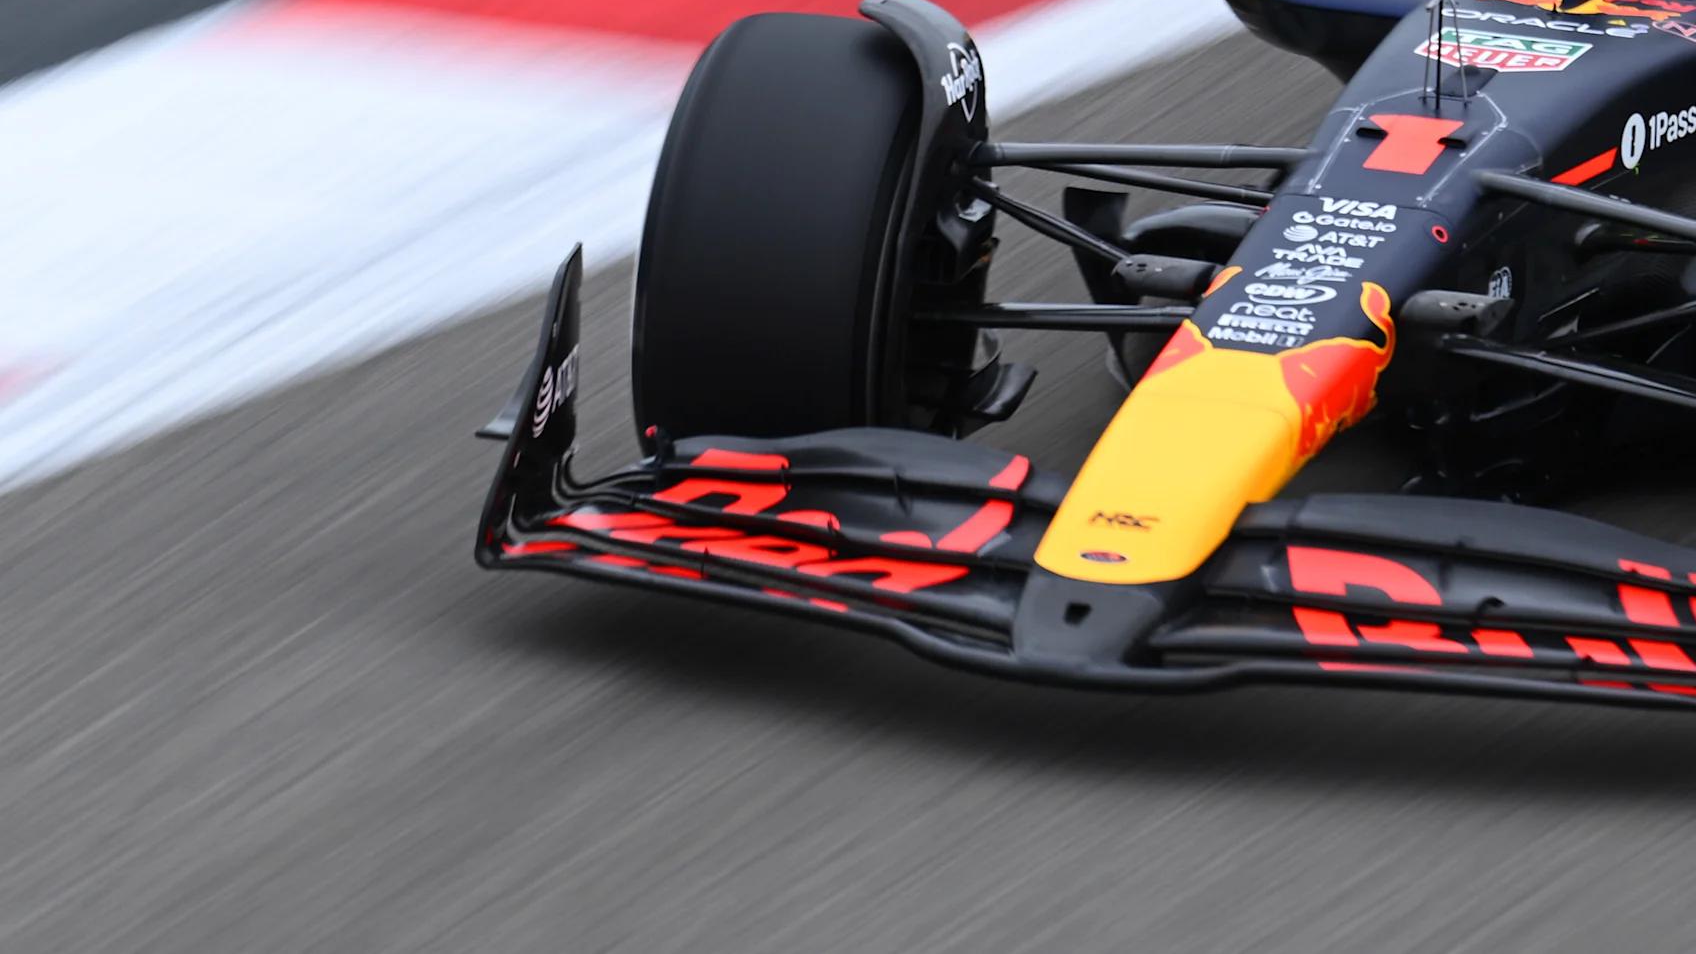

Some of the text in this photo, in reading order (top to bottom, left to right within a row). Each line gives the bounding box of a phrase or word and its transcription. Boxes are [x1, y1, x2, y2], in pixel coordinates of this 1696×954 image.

[1441, 8, 1636, 39] ORACLE
[1451, 31, 1574, 55] TAG
[1429, 43, 1563, 68] HEUER
[1363, 114, 1464, 174] 1
[1319, 197, 1397, 220] VISA
[1315, 214, 1396, 232] Gate.io
[1318, 231, 1385, 248] AT&T
[1244, 283, 1316, 300] CDW
[1207, 326, 1278, 346] Mobil
